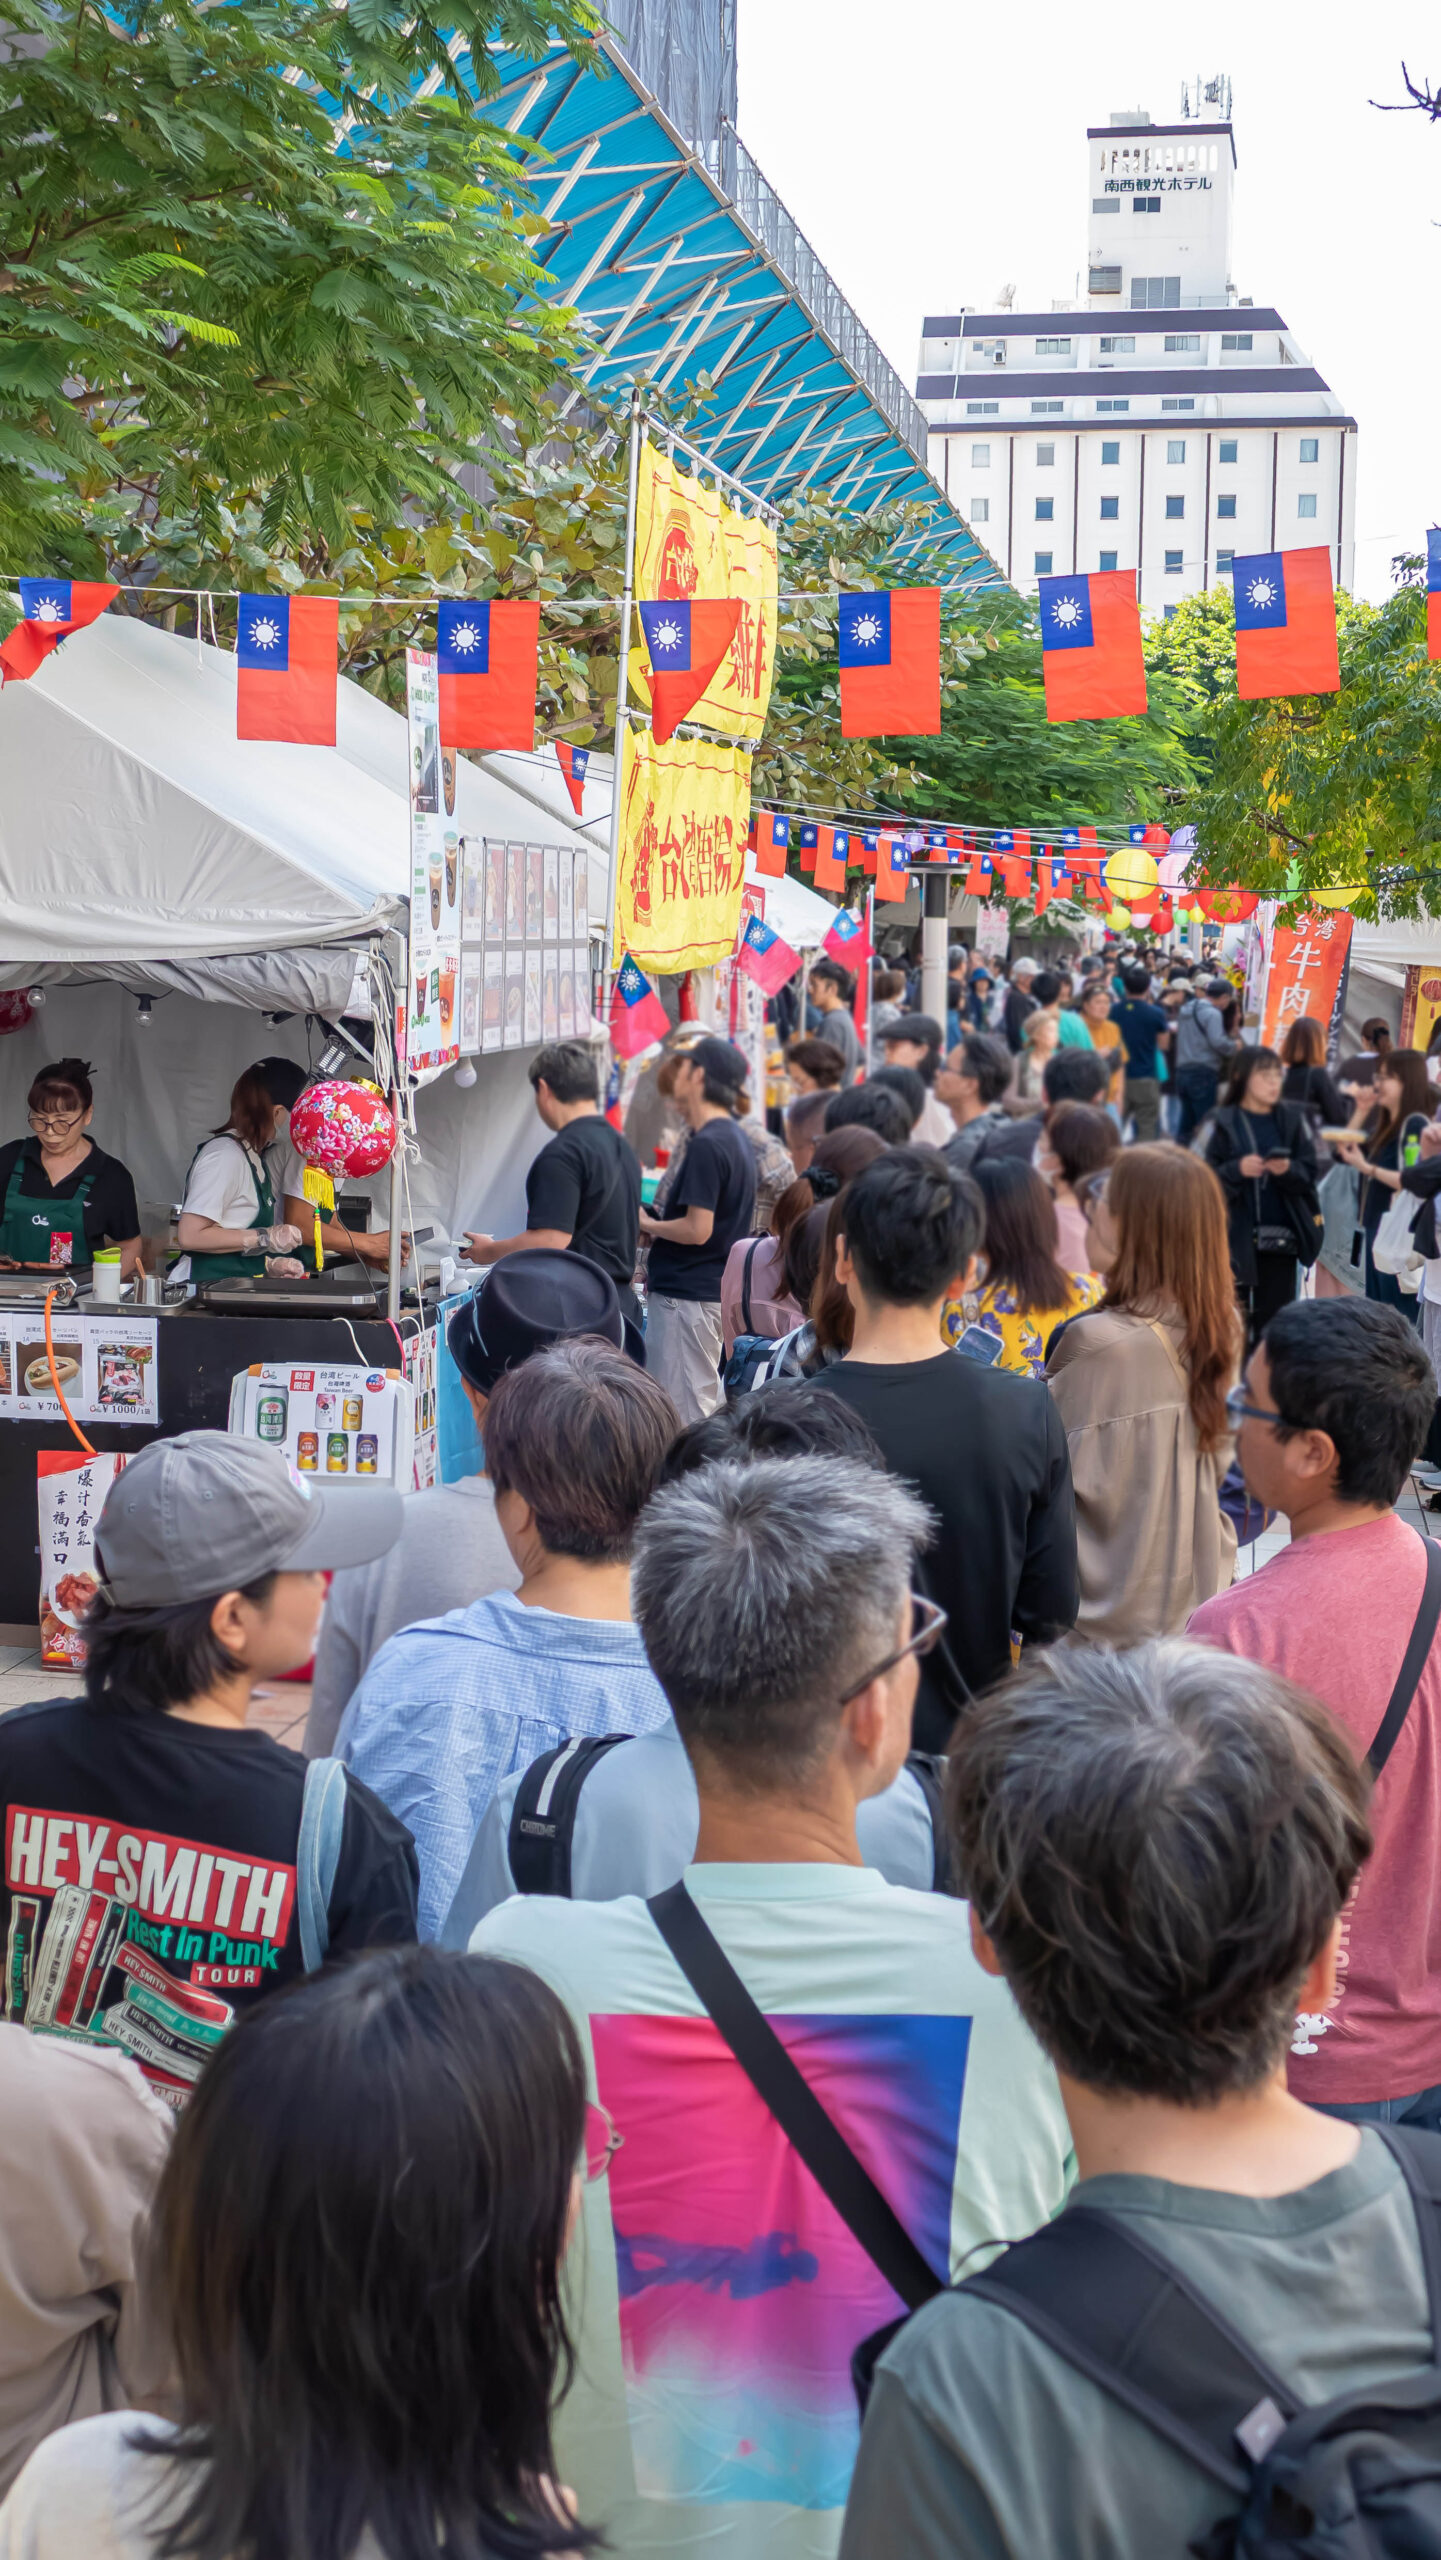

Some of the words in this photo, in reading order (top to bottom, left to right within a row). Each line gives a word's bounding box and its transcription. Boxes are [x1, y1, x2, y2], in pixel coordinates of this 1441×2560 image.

[1104, 177, 1212, 193] 南西観光ホテル
[1293, 914, 1337, 941] 台湾
[320, 1370, 360, 1379] 台湾ビール
[76, 1468, 93, 1547] 爆汁香氣
[520, 1819, 556, 1838] CHROME
[10, 1812, 288, 1939] HEY-SMITH
[126, 1908, 174, 1958] Rest
[175, 1926, 204, 1960] In
[208, 1931, 280, 1970] Punk
[123, 1955, 167, 1992] HEY-SMITH
[196, 1966, 255, 1984] TOUR
